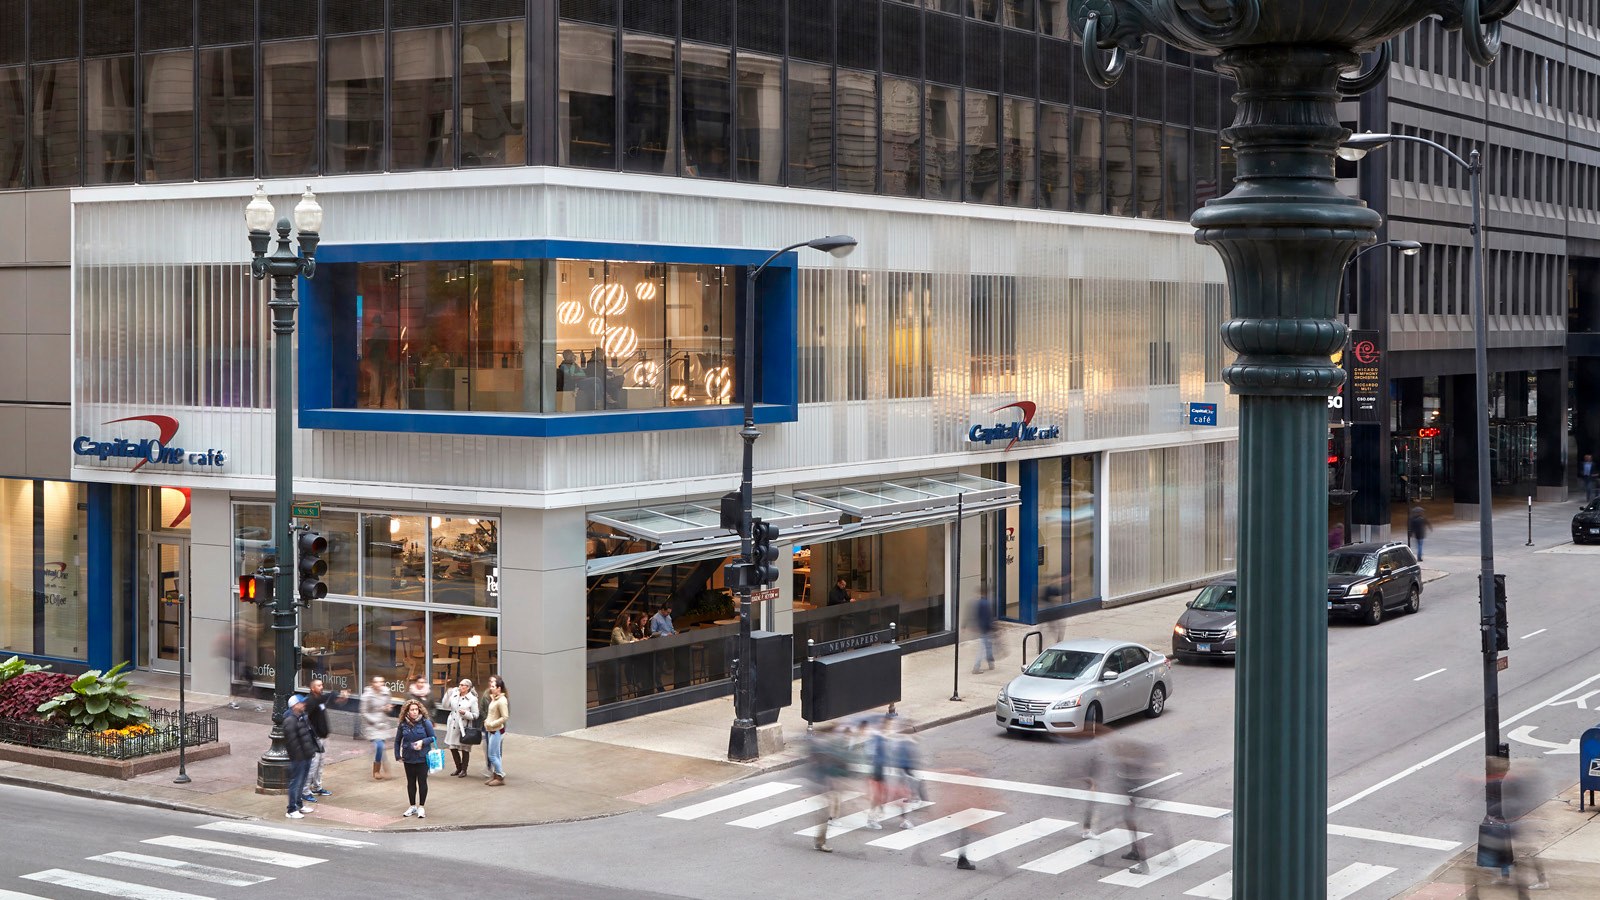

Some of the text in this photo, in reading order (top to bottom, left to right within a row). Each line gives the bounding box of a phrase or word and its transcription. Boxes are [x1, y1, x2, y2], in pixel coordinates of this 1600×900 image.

[1193, 416, 1211, 424] café
[1037, 424, 1059, 439] café
[188, 448, 225, 467] café
[829, 634, 878, 651] NEWSPAPERS
[252, 664, 276, 676] coffe
[311, 670, 348, 688] banking
[384, 680, 404, 692] café
